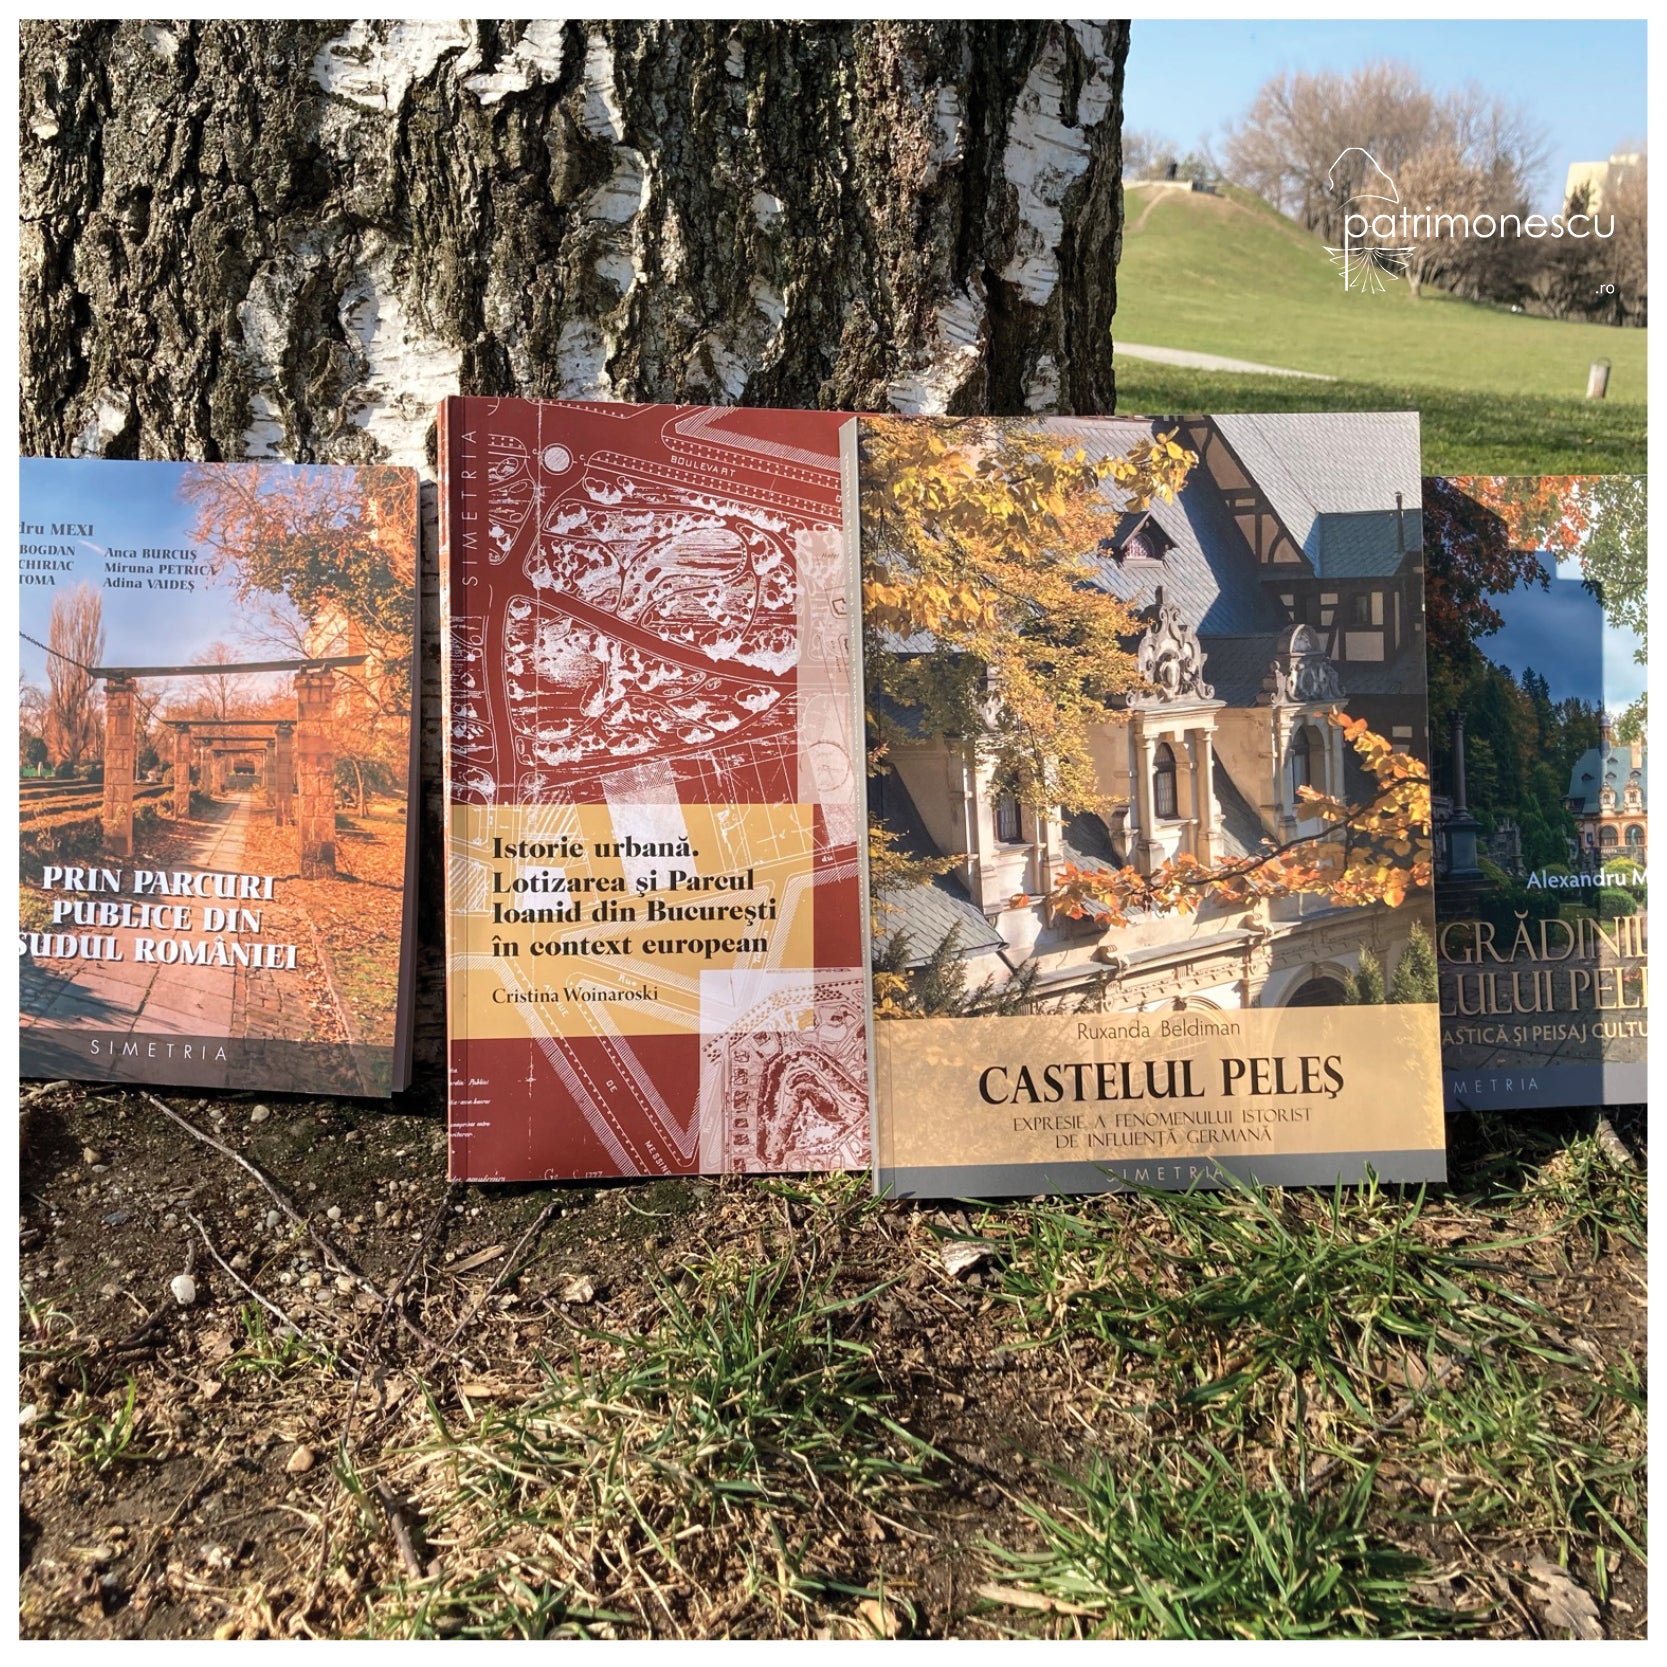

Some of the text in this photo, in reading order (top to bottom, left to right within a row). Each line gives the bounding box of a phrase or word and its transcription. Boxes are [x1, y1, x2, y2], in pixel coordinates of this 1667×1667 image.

[670, 455, 736, 477] BOULEVART
[461, 430, 478, 587] SIMETRIA
[51, 523, 94, 537] MEXI
[20, 544, 76, 556] BOGDAN
[104, 547, 137, 559] Anca
[19, 559, 74, 571] CHIRIAC
[104, 562, 154, 575] Miruna
[103, 577, 142, 589] Adina
[492, 835, 699, 859] Istorie urbană.
[41, 865, 276, 901] PRIN PARCURI
[492, 870, 626, 894] Lotizarea
[669, 869, 754, 892] Parcul
[1527, 870, 1626, 889] Alexandru
[52, 900, 263, 934] PUBLICE DIN
[492, 900, 582, 924] Ioanid
[592, 899, 636, 923] din
[19, 932, 298, 970] SUDUL ROMÂNIEI
[492, 935, 519, 958] în
[530, 936, 633, 956] context
[642, 936, 768, 960] european
[492, 985, 659, 1004] Cristina Woinaroski
[1076, 1018, 1241, 1041] Ruxanda Beldiman
[1533, 1022, 1587, 1044] PEISAJ
[1592, 1021, 1648, 1039] CULTU
[90, 1038, 228, 1061] SIMETRIA
[978, 1058, 1206, 1106] CASTELUL
[1453, 1077, 1539, 1095] METRIA
[1013, 1105, 1312, 1132] EXPRESIE A FENOMENULUI ISTORIST
[1055, 1132, 1079, 1149] DE
[1186, 1124, 1273, 1144] GERMANĂ
[1106, 1165, 1225, 1183] SIMETRIA
